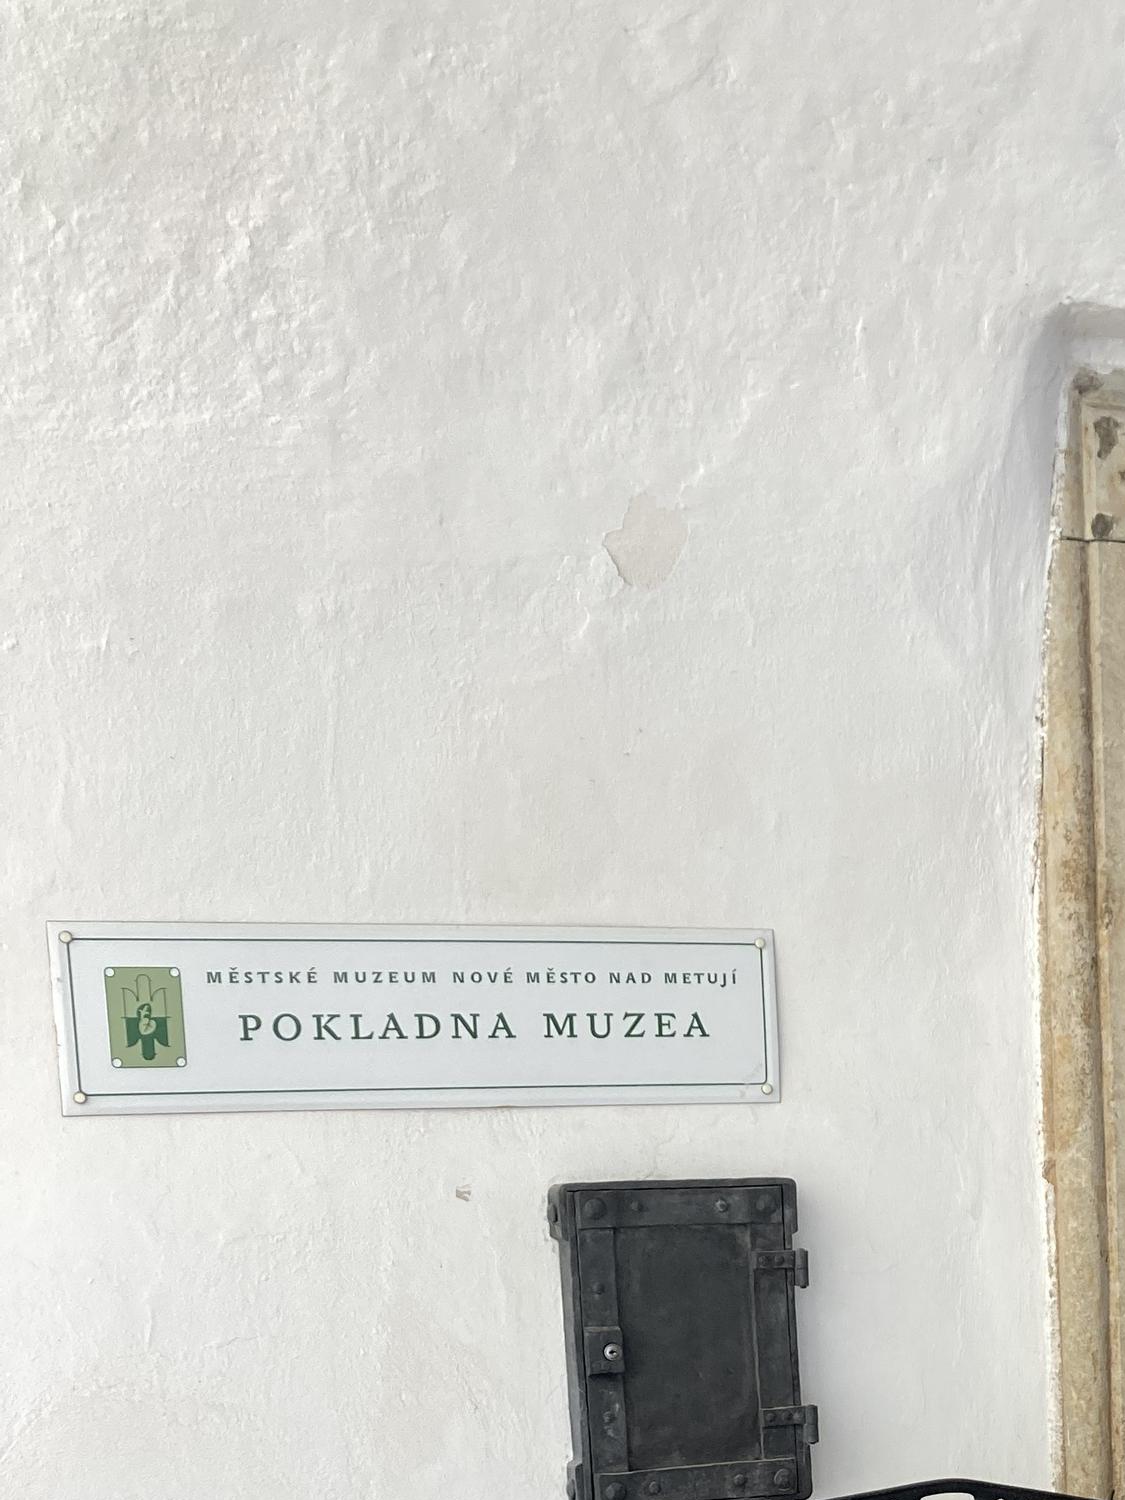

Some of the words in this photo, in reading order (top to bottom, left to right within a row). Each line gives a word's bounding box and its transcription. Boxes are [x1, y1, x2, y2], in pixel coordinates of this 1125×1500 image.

[206, 966, 318, 984] MĚSTSKÉ
[333, 971, 437, 984] MUZEUM
[452, 967, 514, 984] NOVÉ
[526, 968, 597, 984] MĚSTO
[609, 971, 652, 985] NAD
[664, 968, 737, 988] METUJÍ
[238, 1011, 517, 1042] POKLADNA
[542, 1011, 710, 1039] MUZEA
